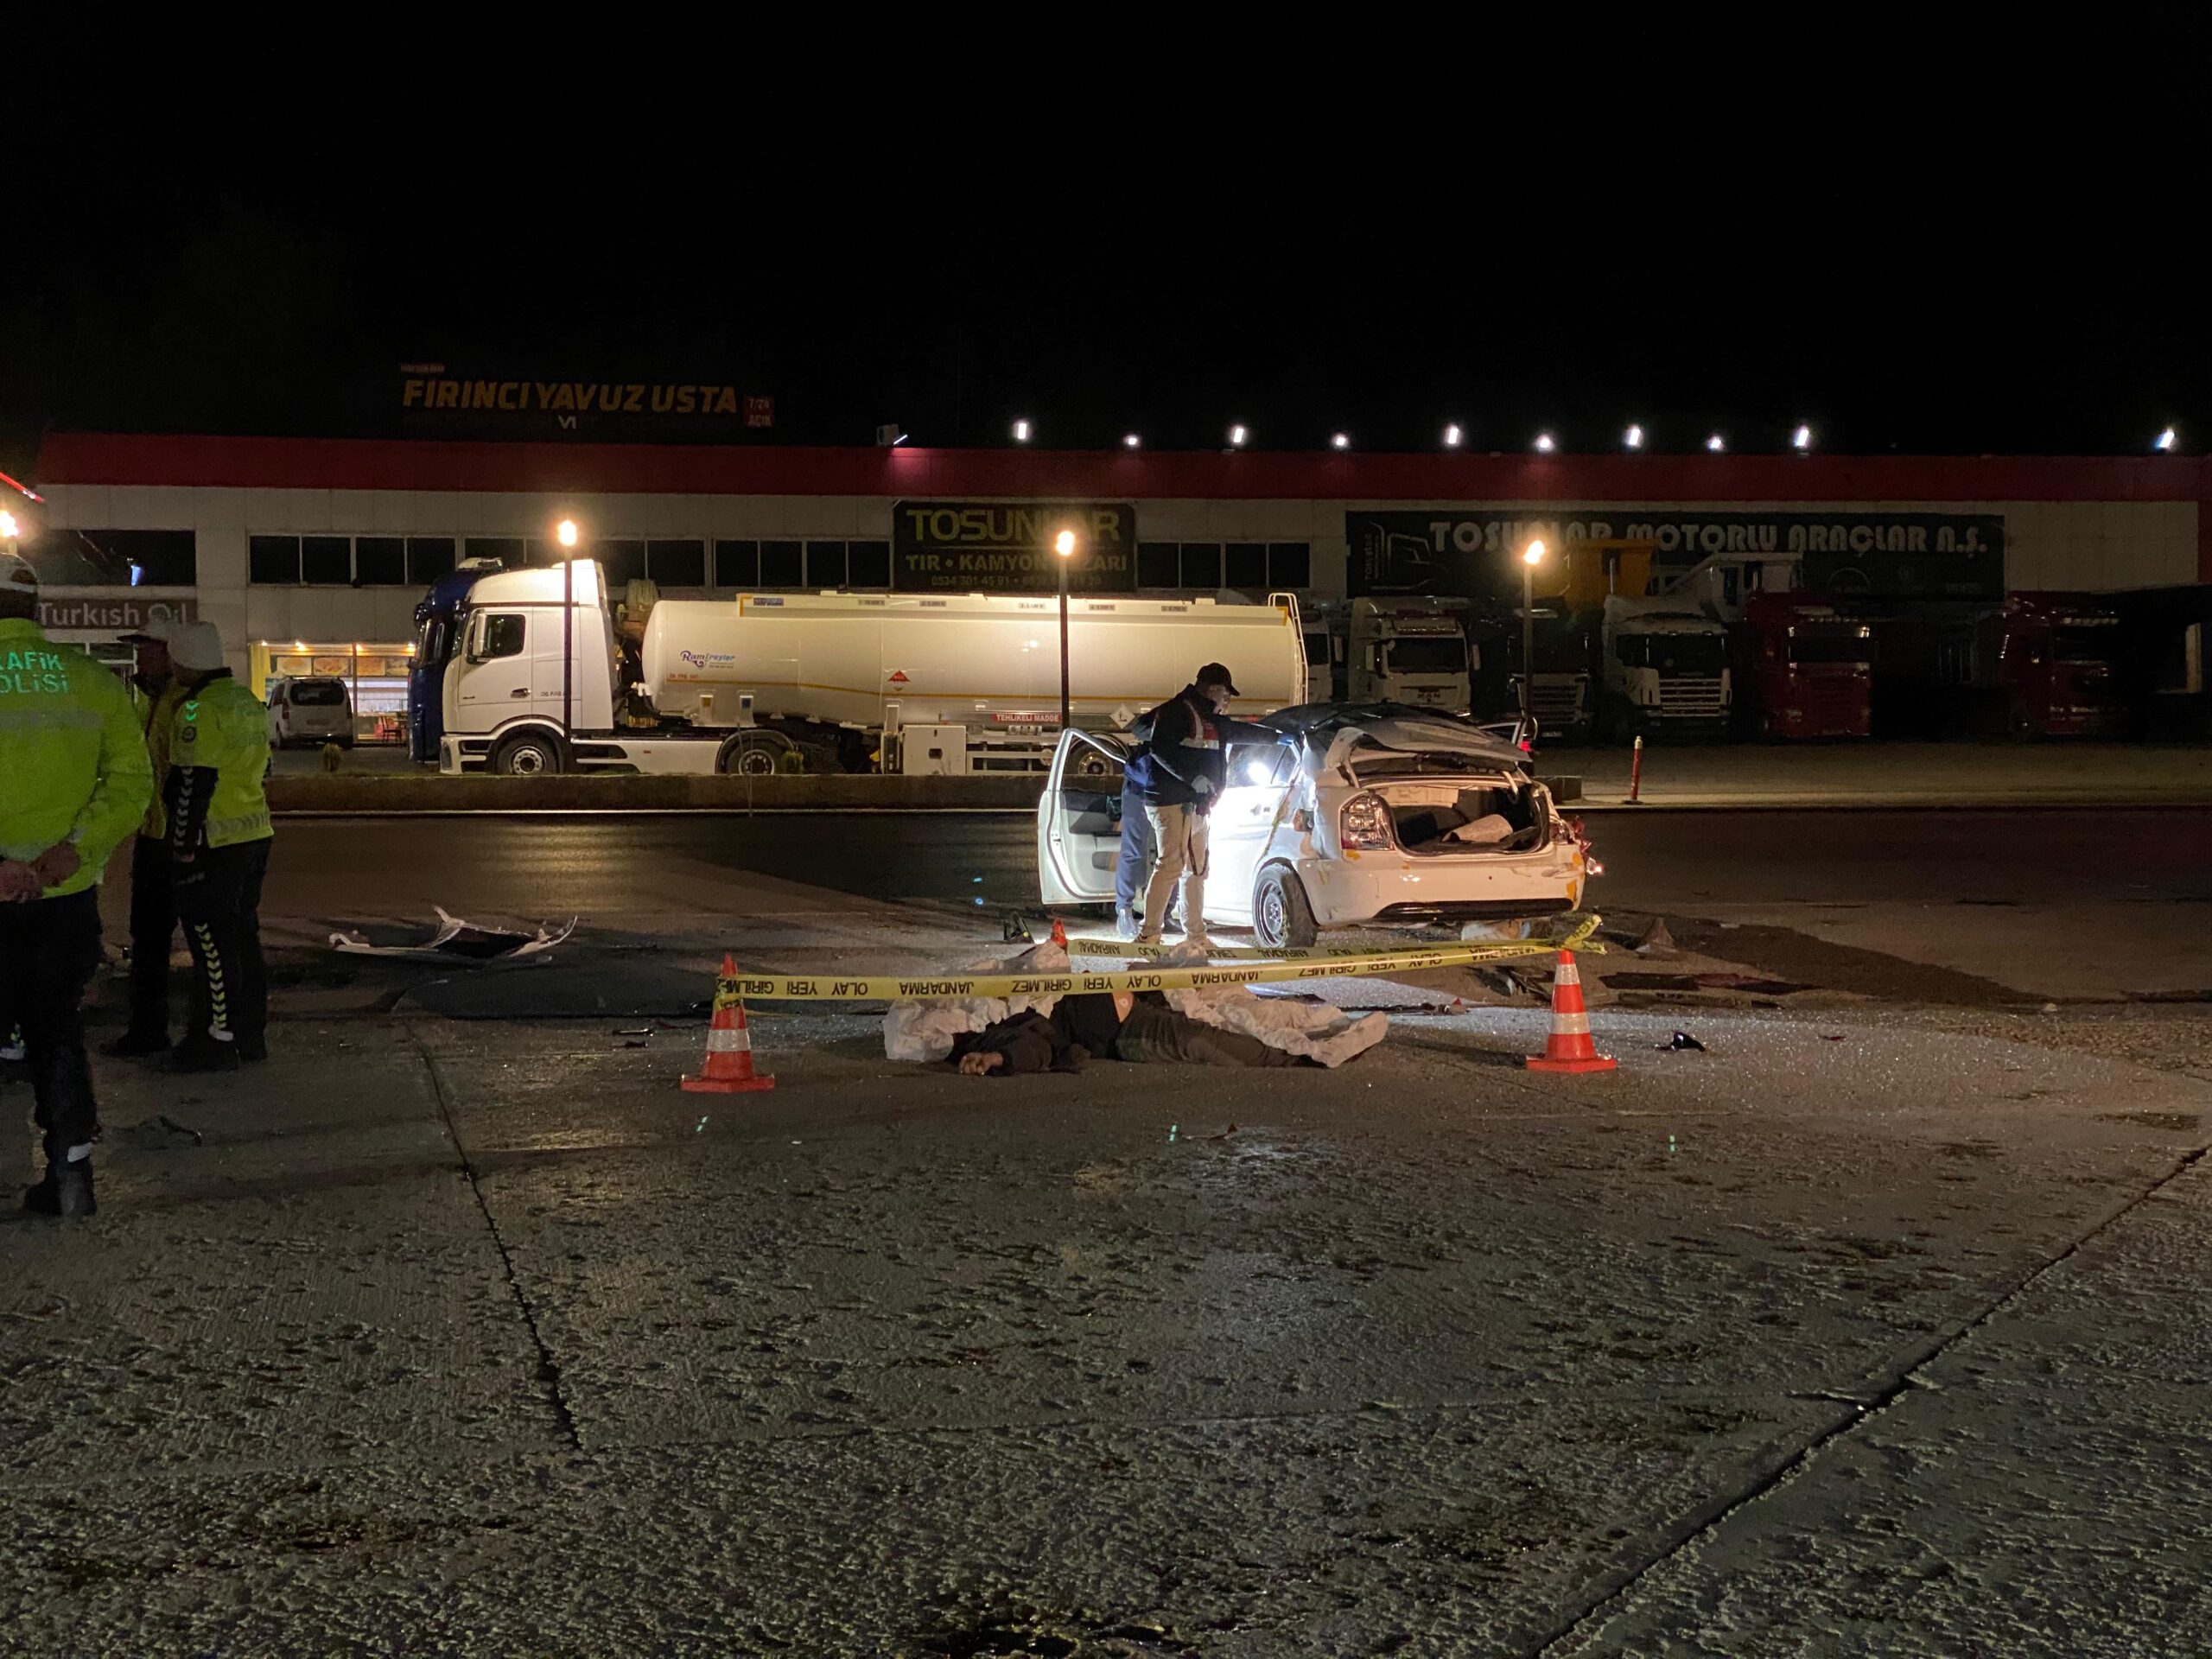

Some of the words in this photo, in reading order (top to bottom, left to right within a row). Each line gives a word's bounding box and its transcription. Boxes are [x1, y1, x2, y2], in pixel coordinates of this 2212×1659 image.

[402, 379, 531, 410] FIRINCI
[536, 381, 645, 413] YAVUZ
[651, 385, 737, 415] USTA
[1788, 524, 1928, 557] ARAÇLAR
[906, 554, 941, 571] TIR
[39, 602, 139, 626] Turkish
[0, 652, 64, 671] AFİK
[0, 674, 68, 693] OLİSİ
[1126, 976, 1162, 988] OLAY
[1192, 970, 1263, 985] JANDARMA
[831, 982, 868, 995] OLAY
[899, 982, 974, 995] JANDARMA
